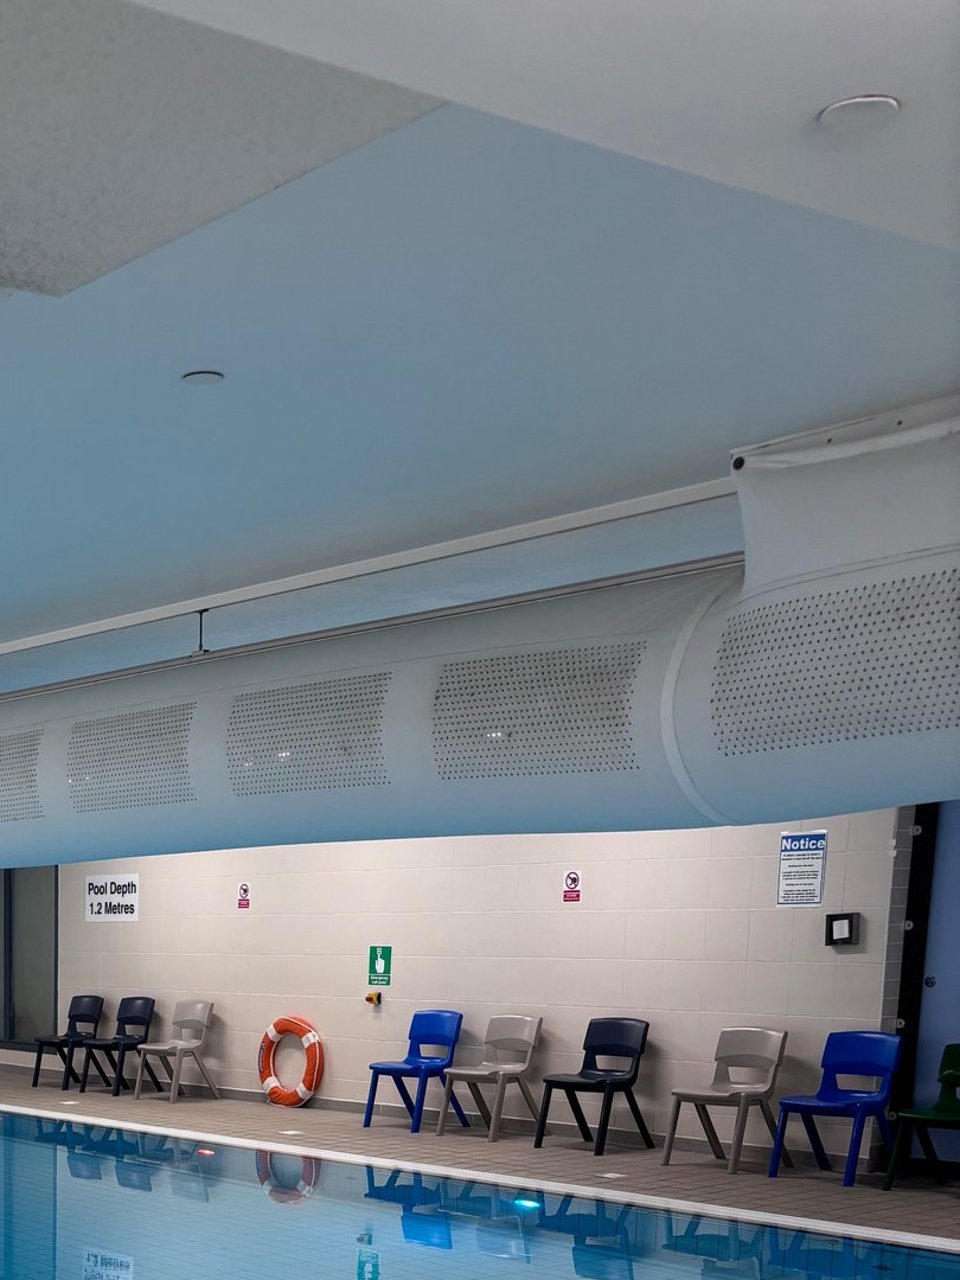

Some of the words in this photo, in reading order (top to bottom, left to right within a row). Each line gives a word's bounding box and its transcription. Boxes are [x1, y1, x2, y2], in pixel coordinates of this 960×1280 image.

[782, 837, 825, 850] Notice
[88, 882, 107, 895] Pool
[110, 881, 137, 897] Depth
[89, 902, 102, 915] 1.2
[104, 902, 135, 914] Metres
